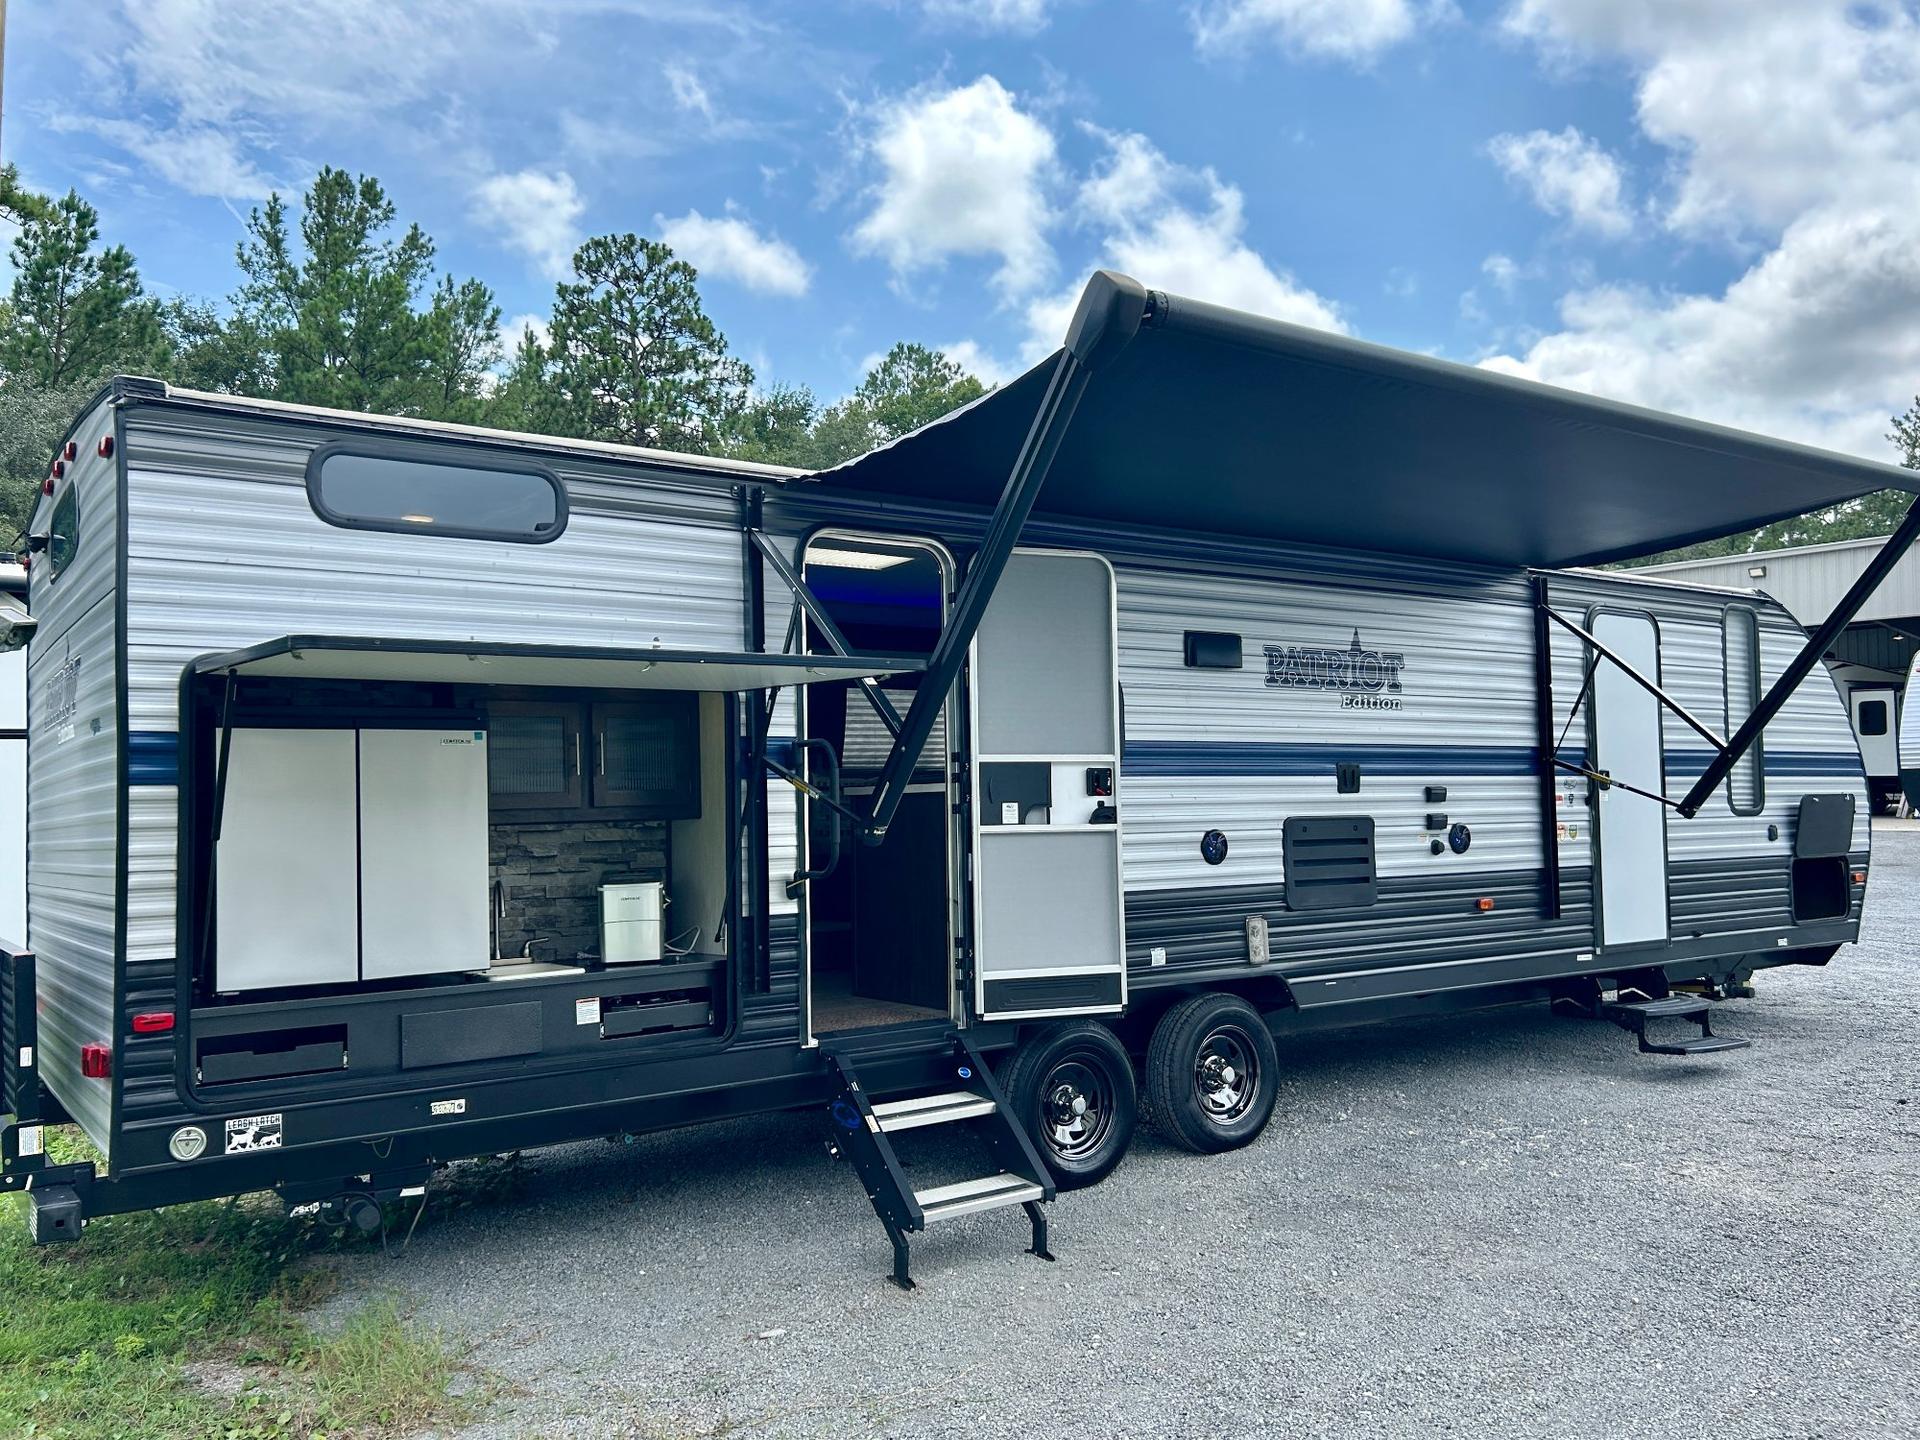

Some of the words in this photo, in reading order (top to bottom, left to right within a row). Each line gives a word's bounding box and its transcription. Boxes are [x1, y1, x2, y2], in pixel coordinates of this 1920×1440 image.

[1263, 645, 1405, 692] PATRIOT
[1341, 693, 1402, 710] Edition
[228, 1119, 254, 1130] LEASH
[255, 1115, 281, 1126] LATCH
